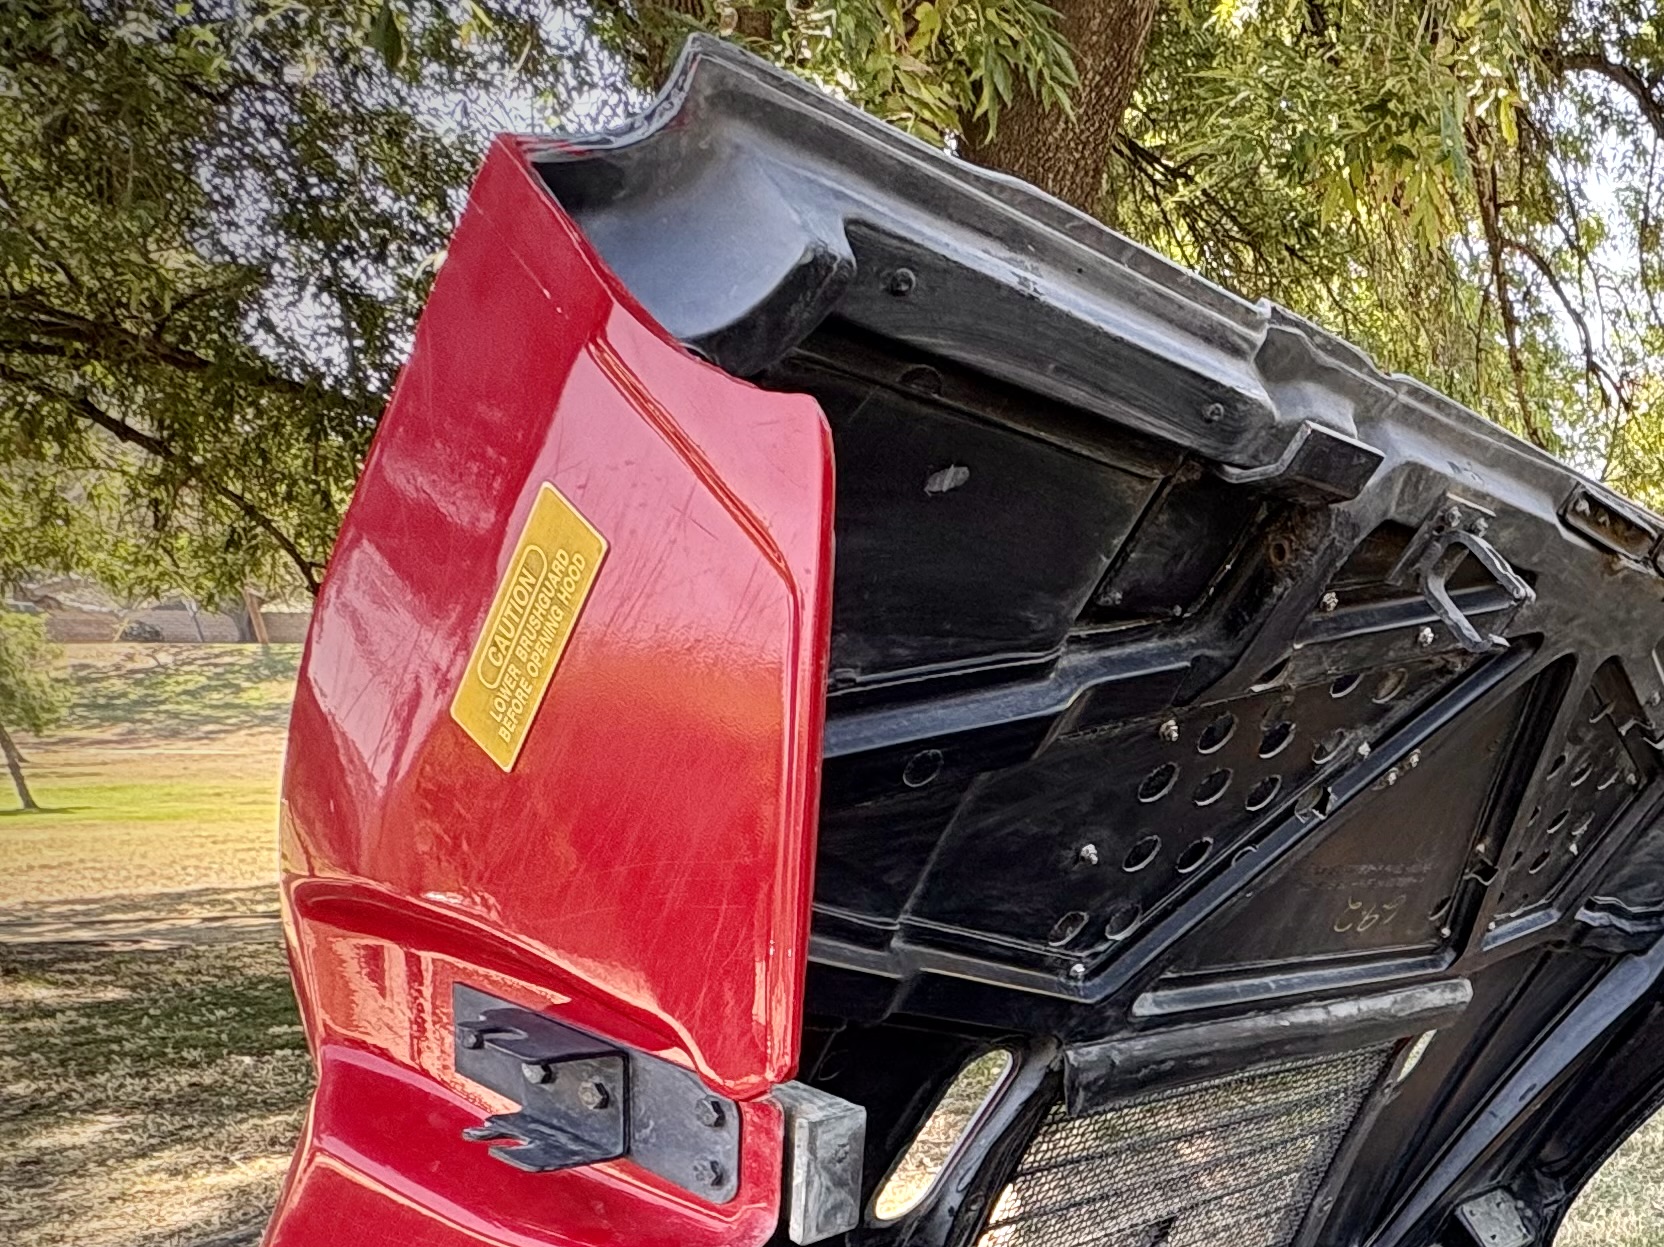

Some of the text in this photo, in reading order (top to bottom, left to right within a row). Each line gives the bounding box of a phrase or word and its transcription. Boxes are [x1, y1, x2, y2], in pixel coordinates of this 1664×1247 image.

[488, 565, 537, 667] CAUTION
[490, 548, 571, 724] LOWER BRUSHGUARD
[498, 552, 587, 744] BEFORE OPENING HOOD
